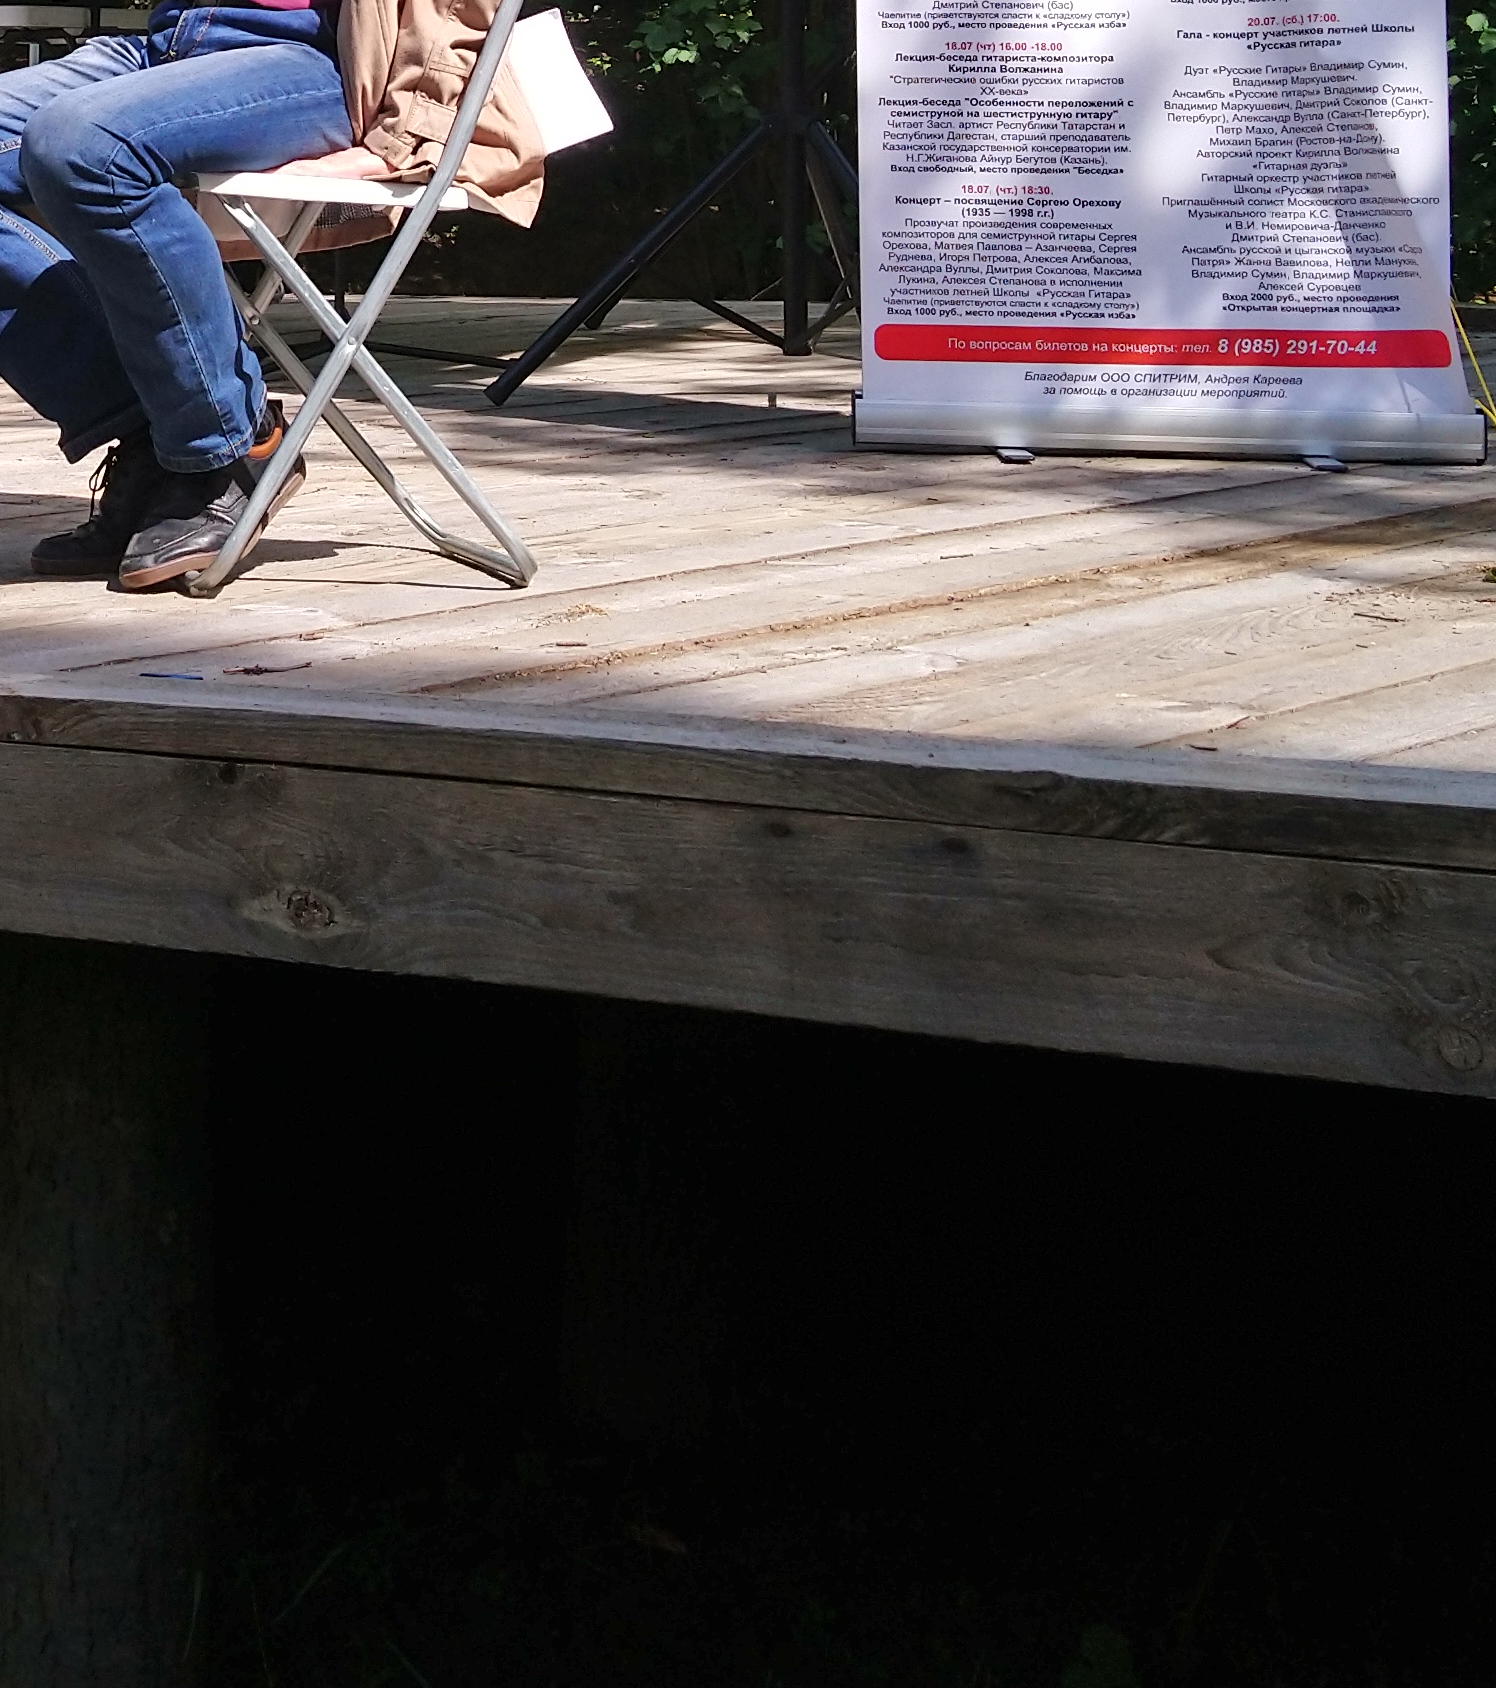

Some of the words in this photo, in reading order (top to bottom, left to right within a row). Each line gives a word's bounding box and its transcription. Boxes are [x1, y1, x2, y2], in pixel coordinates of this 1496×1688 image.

[1247, 16, 1280, 27] 20.07.
[1282, 14, 1303, 26] (сб.)
[1307, 13, 1340, 24] 17:00.
[1176, 30, 1202, 39] Гала
[1212, 29, 1259, 39] концерт
[1261, 27, 1323, 39] участников
[1371, 24, 1414, 34] Школы
[998, 41, 1027, 51] 16.00
[1246, 40, 1296, 52] «Русская
[1299, 37, 1341, 49] гитара»
[895, 52, 977, 64] Лекция-беседа
[981, 54, 1113, 64] гитариста-композитора
[948, 64, 996, 75] Кирилла
[999, 64, 1063, 74] Волжанина
[995, 185, 1018, 196] (чт.)
[1021, 185, 1053, 195] 18:30.
[895, 196, 940, 207] Концерт
[1026, 197, 1069, 208] Сергею
[1221, 293, 1248, 303] Вход
[1250, 293, 1273, 301] 2000
[1302, 294, 1333, 302] место
[1335, 295, 1399, 303] проведения
[1280, 305, 1339, 314] концертная
[948, 337, 966, 349] По
[969, 340, 1031, 352] вопросам
[1035, 339, 1088, 351] билетов
[1092, 341, 1108, 351] на
[1111, 342, 1177, 354] концерты:
[1181, 342, 1212, 352] тел.
[1218, 338, 1228, 354] 8
[1234, 338, 1280, 358] (985)
[1286, 340, 1378, 354] 291-70-44
[1024, 371, 1096, 384] Благодарим
[1100, 372, 1130, 383] ООО
[1204, 374, 1248, 386] Андрея
[1042, 386, 1056, 395] за
[1059, 386, 1107, 397] помощь
[1110, 387, 1117, 396] в
[1120, 387, 1197, 399] организации
[1200, 388, 1287, 400] мероприятий.
